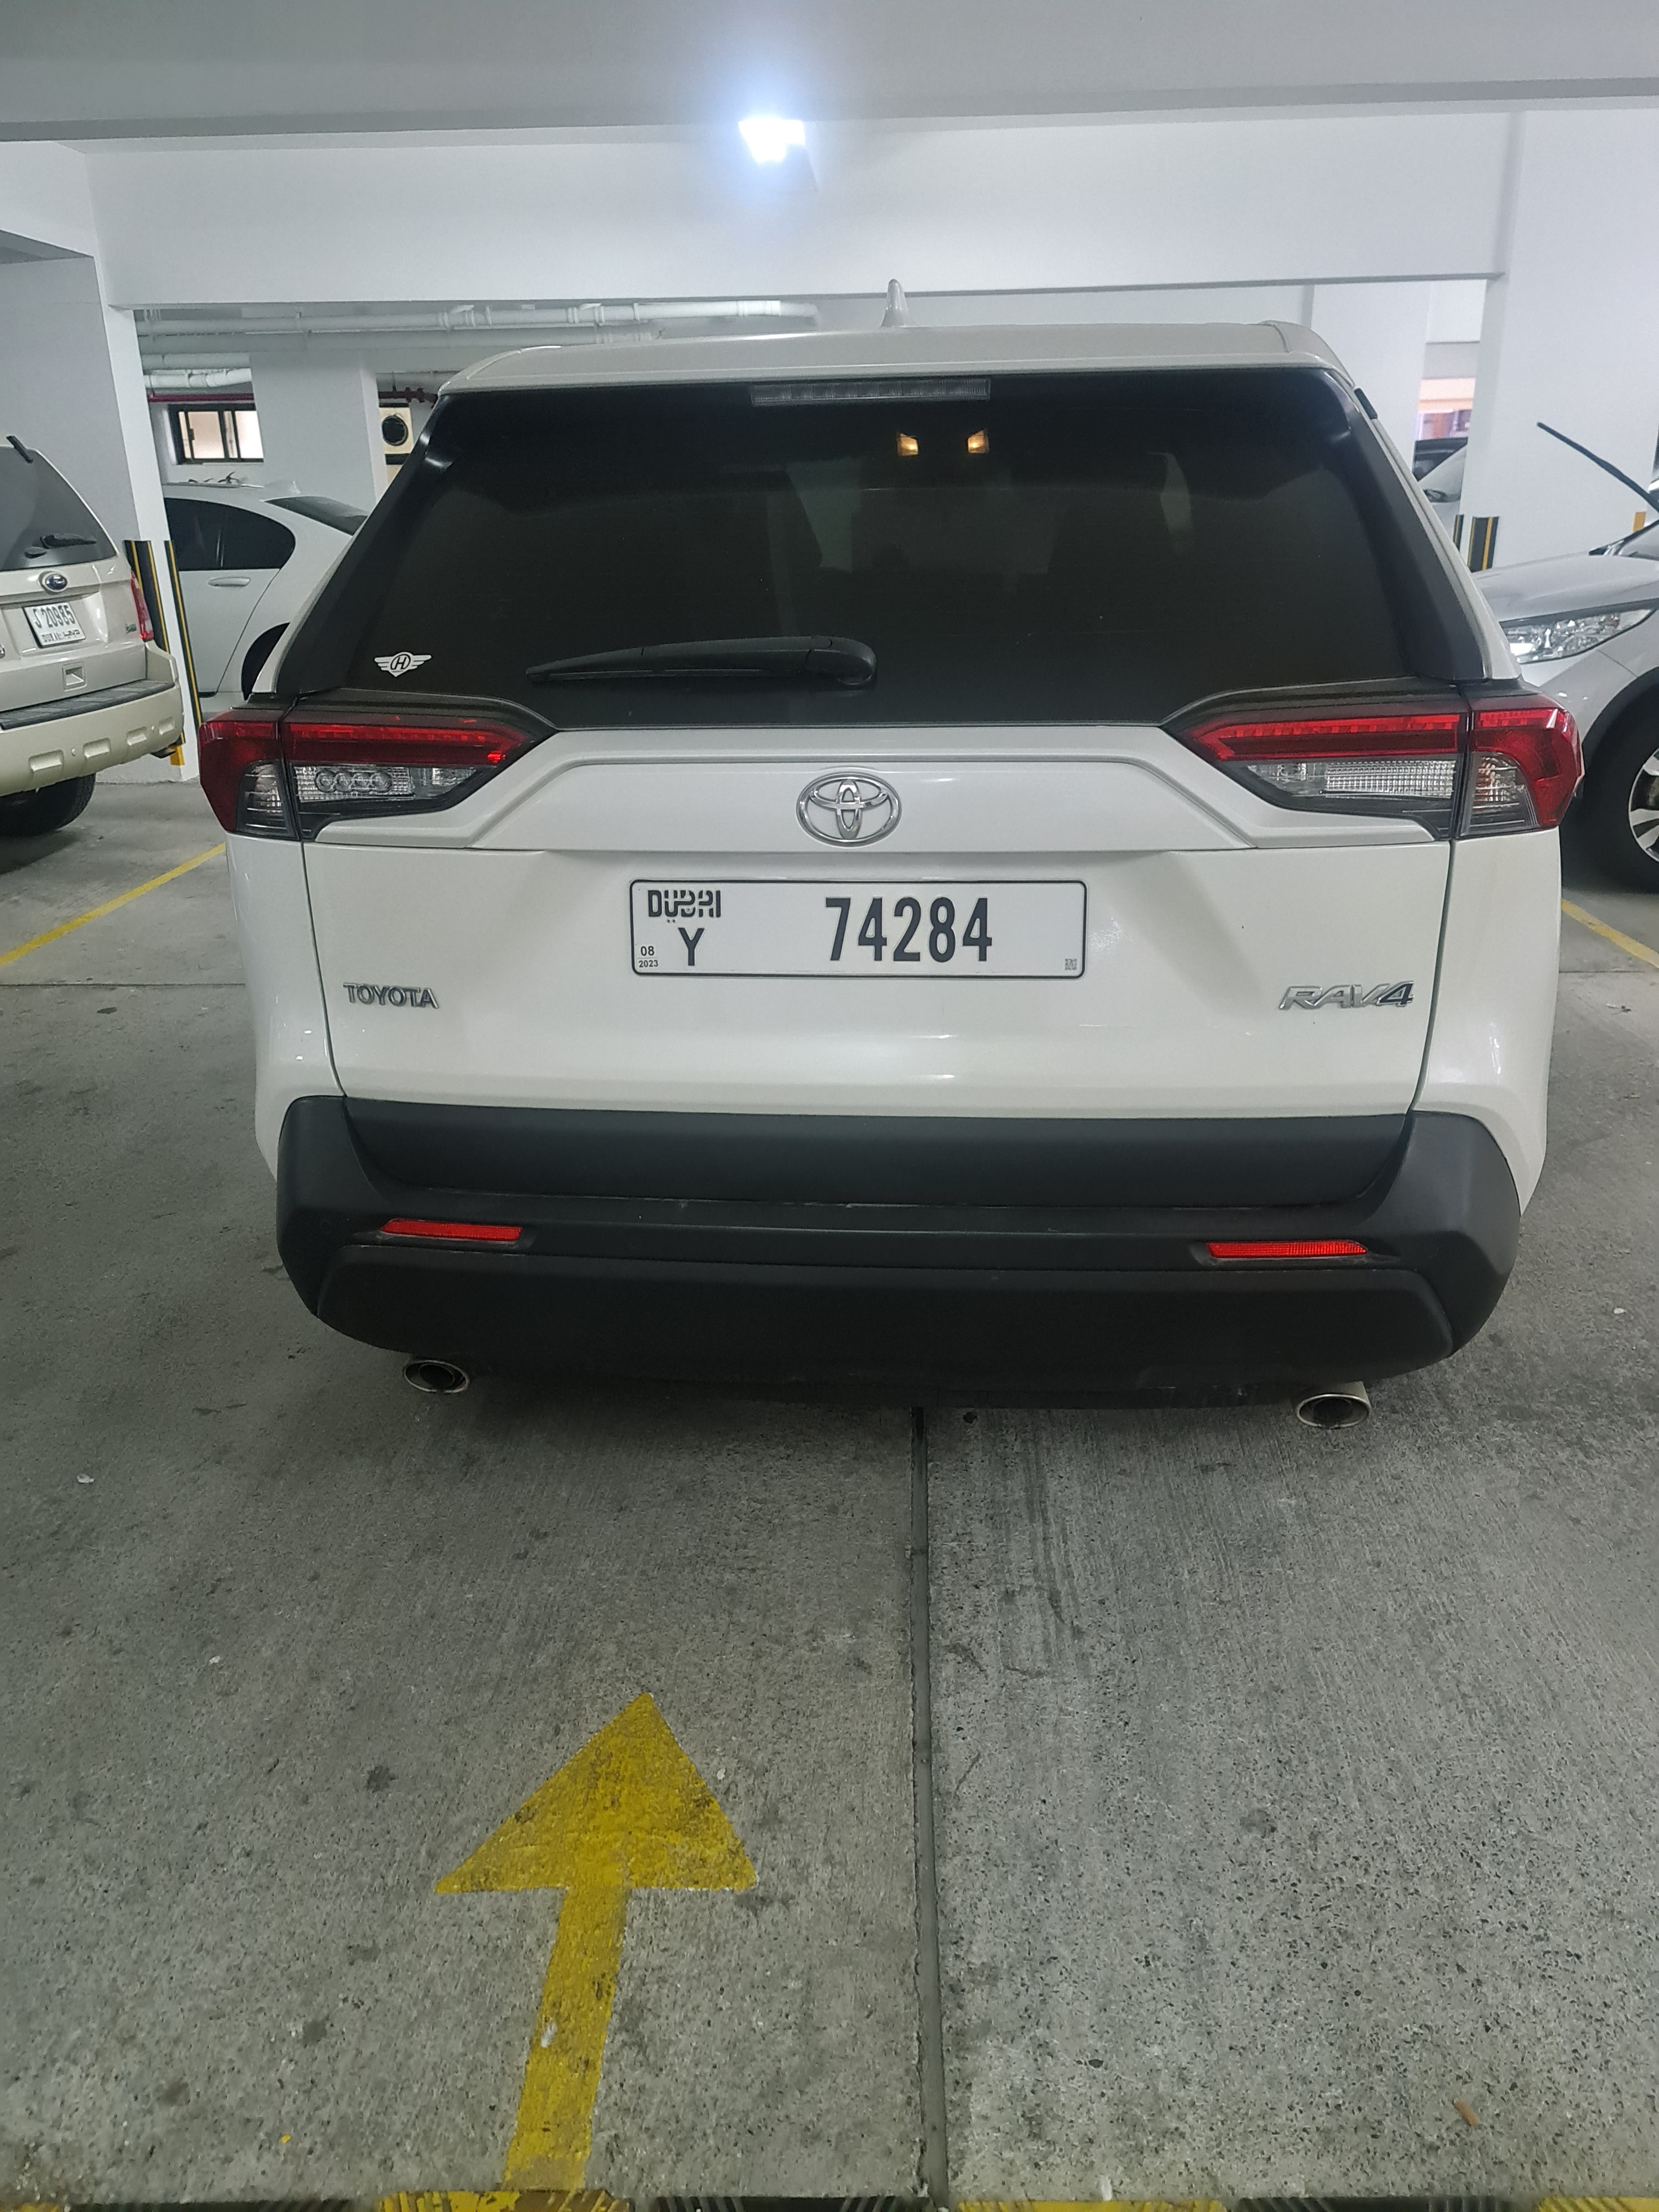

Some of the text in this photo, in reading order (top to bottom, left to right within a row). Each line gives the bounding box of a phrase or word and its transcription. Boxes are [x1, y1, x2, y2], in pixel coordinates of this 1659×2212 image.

[40, 604, 76, 628] 20985
[648, 890, 722, 918] DUBAI
[825, 896, 993, 963] 74284
[640, 945, 655, 957] 08
[678, 927, 705, 966] Y
[638, 959, 659, 968] 2023
[342, 982, 440, 1009] TOYOTA
[1278, 980, 1415, 1010] RAV4
